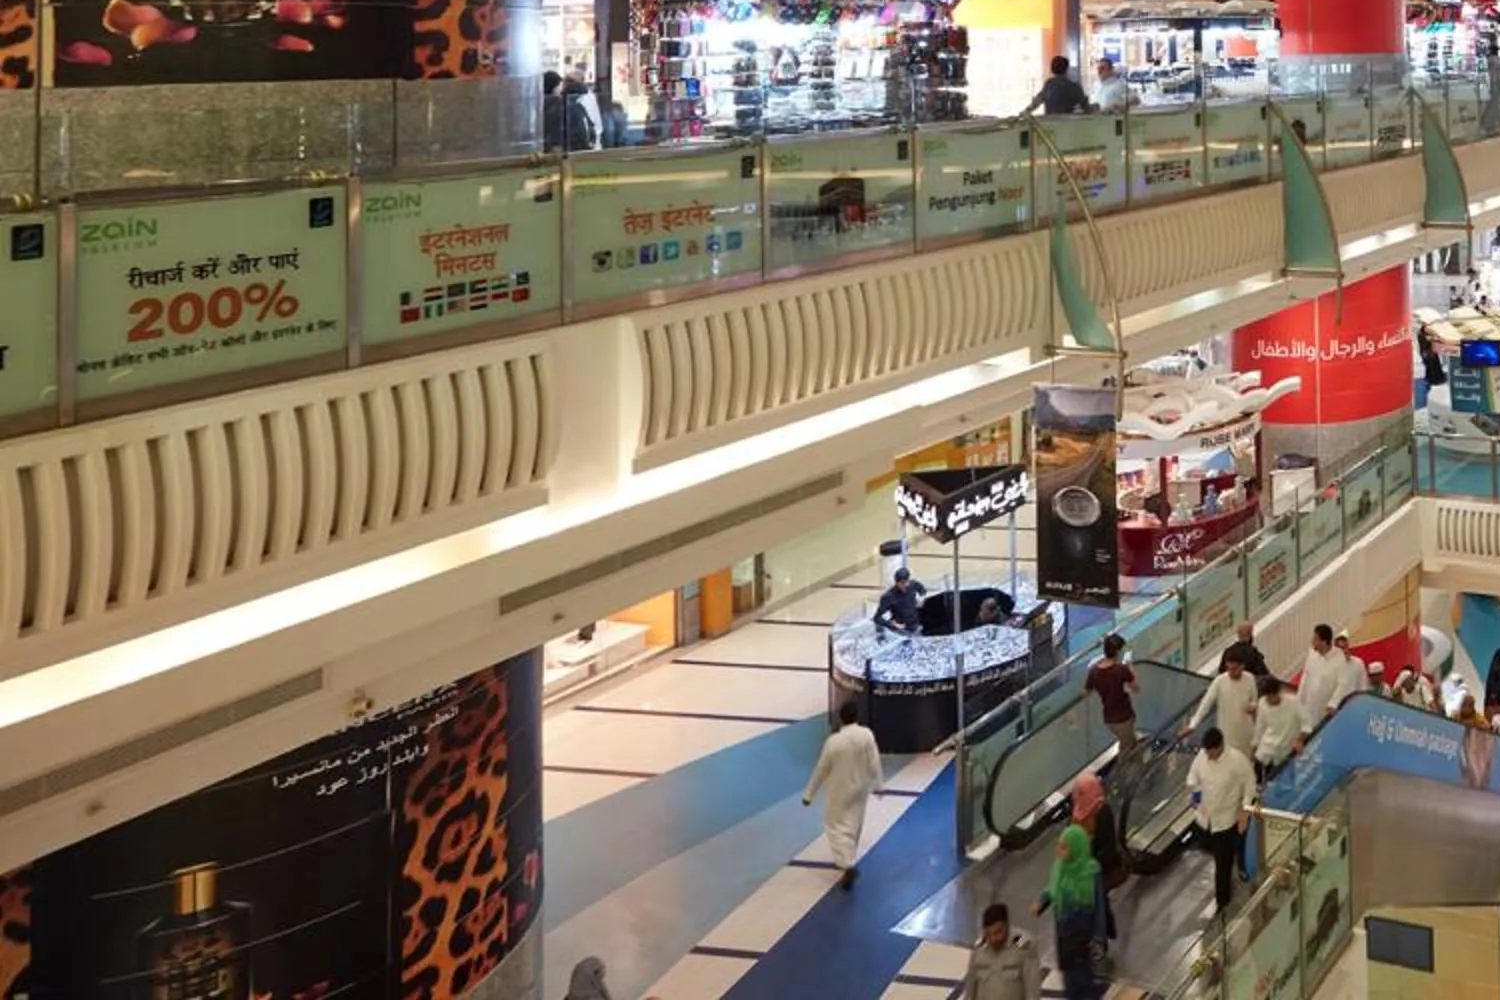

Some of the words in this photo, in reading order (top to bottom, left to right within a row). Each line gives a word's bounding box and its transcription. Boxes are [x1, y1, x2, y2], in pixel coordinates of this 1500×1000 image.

[962, 169, 994, 186] Paket
[127, 260, 184, 289] रीचार्ज
[191, 256, 221, 281] करें
[228, 252, 263, 276] और
[127, 279, 300, 343] 200%
